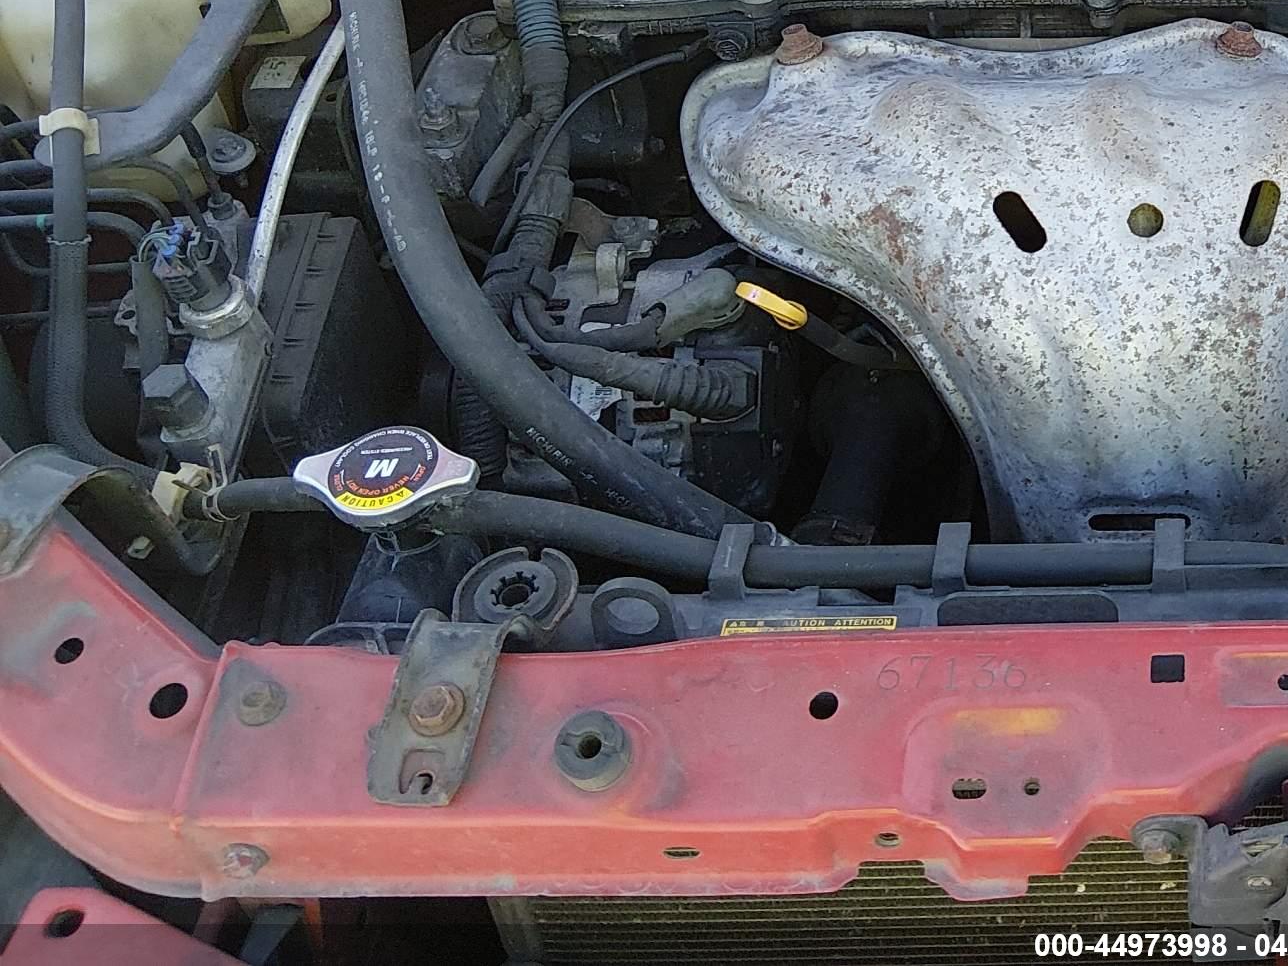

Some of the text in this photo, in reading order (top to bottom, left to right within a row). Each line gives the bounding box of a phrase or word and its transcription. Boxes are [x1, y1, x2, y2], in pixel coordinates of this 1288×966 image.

[364, 458, 399, 479] M
[382, 475, 410, 493] NEVER
[341, 494, 394, 507] CAUTION
[783, 618, 892, 627] AUTION ATTENTION
[877, 653, 1027, 691] 67136
